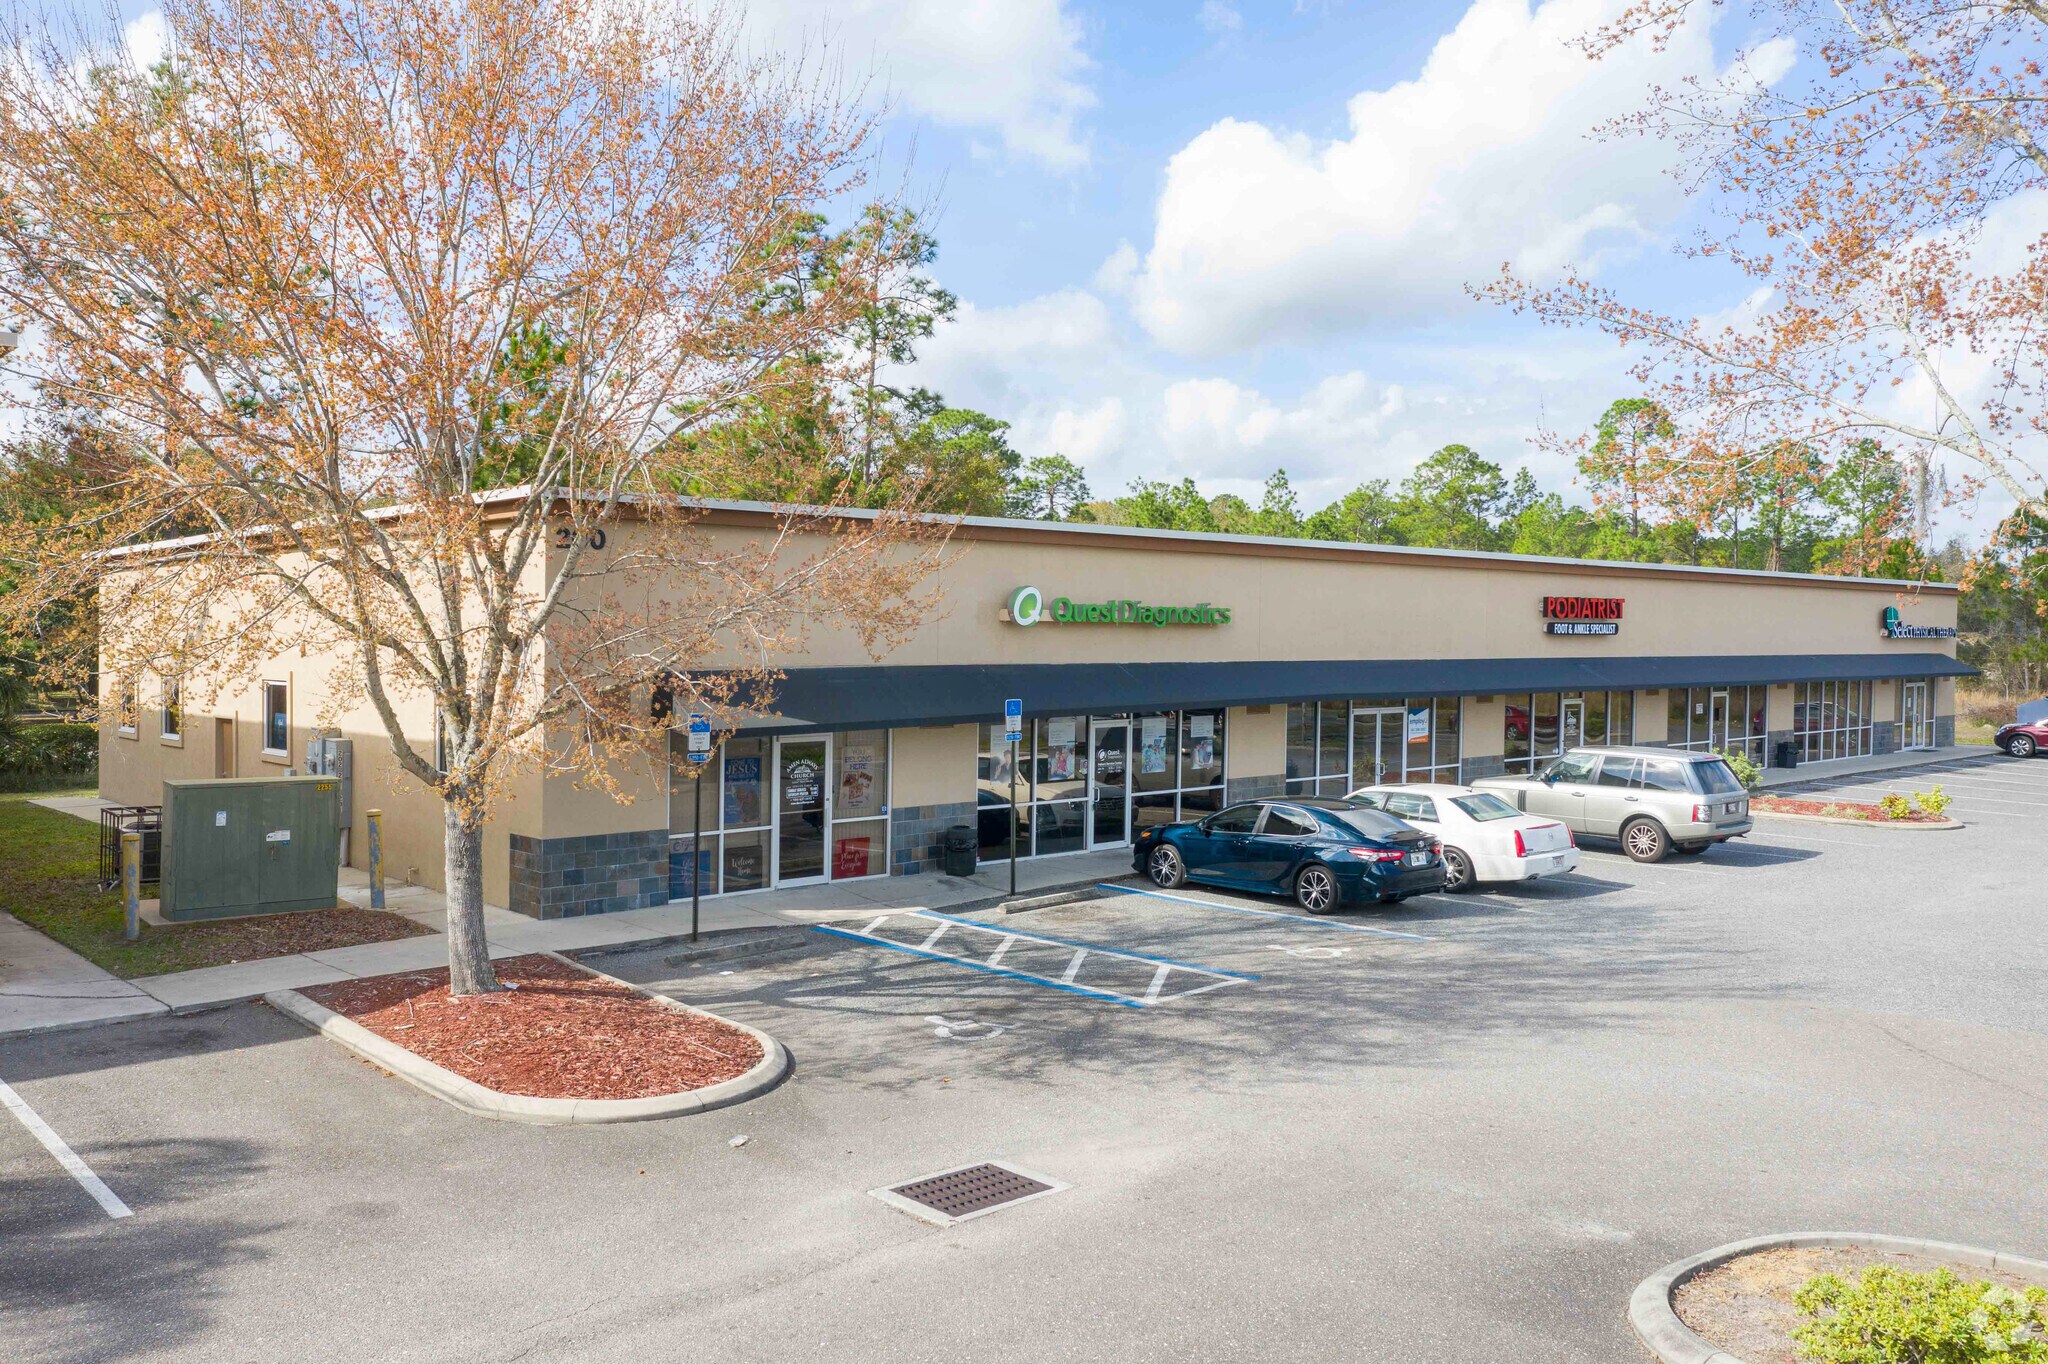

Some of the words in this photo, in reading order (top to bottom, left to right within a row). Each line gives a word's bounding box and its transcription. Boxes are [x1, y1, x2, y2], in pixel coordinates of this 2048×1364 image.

[556, 527, 606, 550] 20
[1051, 597, 1117, 623] Quest
[1122, 600, 1231, 628] Diagnostics
[1545, 596, 1625, 619] PODIATRIST
[1554, 623, 1568, 634] FOOT
[1568, 624, 1573, 634] &
[1574, 624, 1590, 634] ANKLE
[1590, 624, 1616, 634] SPECIALIST
[726, 764, 758, 775] JESUS
